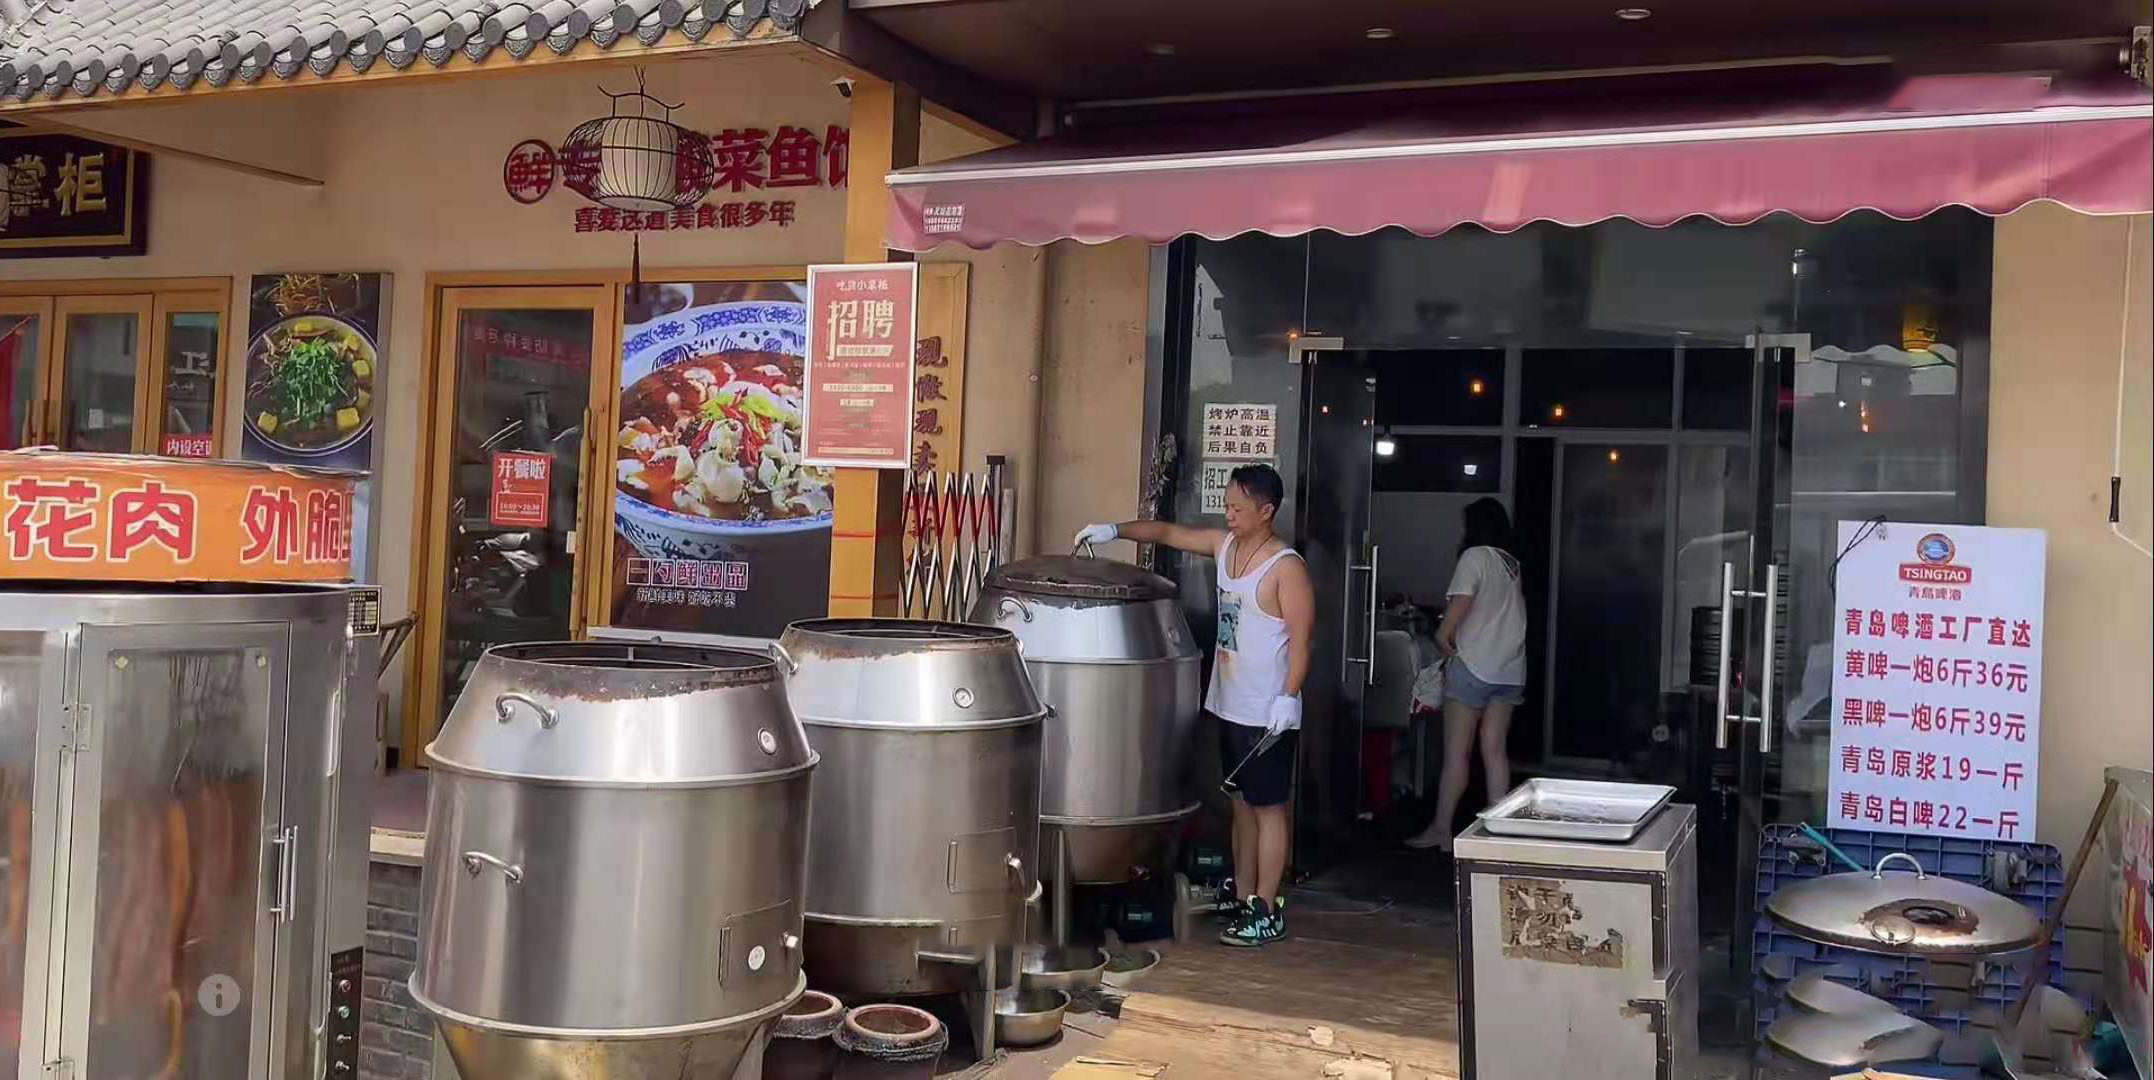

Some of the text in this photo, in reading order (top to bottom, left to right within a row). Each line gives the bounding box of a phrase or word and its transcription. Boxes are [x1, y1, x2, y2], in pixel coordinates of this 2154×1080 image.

[574, 200, 795, 233] 喜爱这道美食很多年
[826, 299, 894, 361] 招聘
[1208, 407, 1270, 421] 烤炉高温
[1208, 424, 1270, 438] 禁止靠近
[1207, 440, 1268, 455] 后果自负
[498, 457, 546, 480] 开餐啦
[4, 477, 198, 565] 花肉
[1903, 567, 1967, 581] TSINGTAO
[1845, 608, 2031, 648] 青岛啤酒工厂直达
[1845, 650, 2028, 693] 黄啤一炮6斤36元
[1842, 698, 2026, 742] 黑啤一炮6斤39元
[1841, 745, 2024, 791] 青岛原浆19一斤
[1839, 791, 2020, 840] 青岛白啤22一斤
